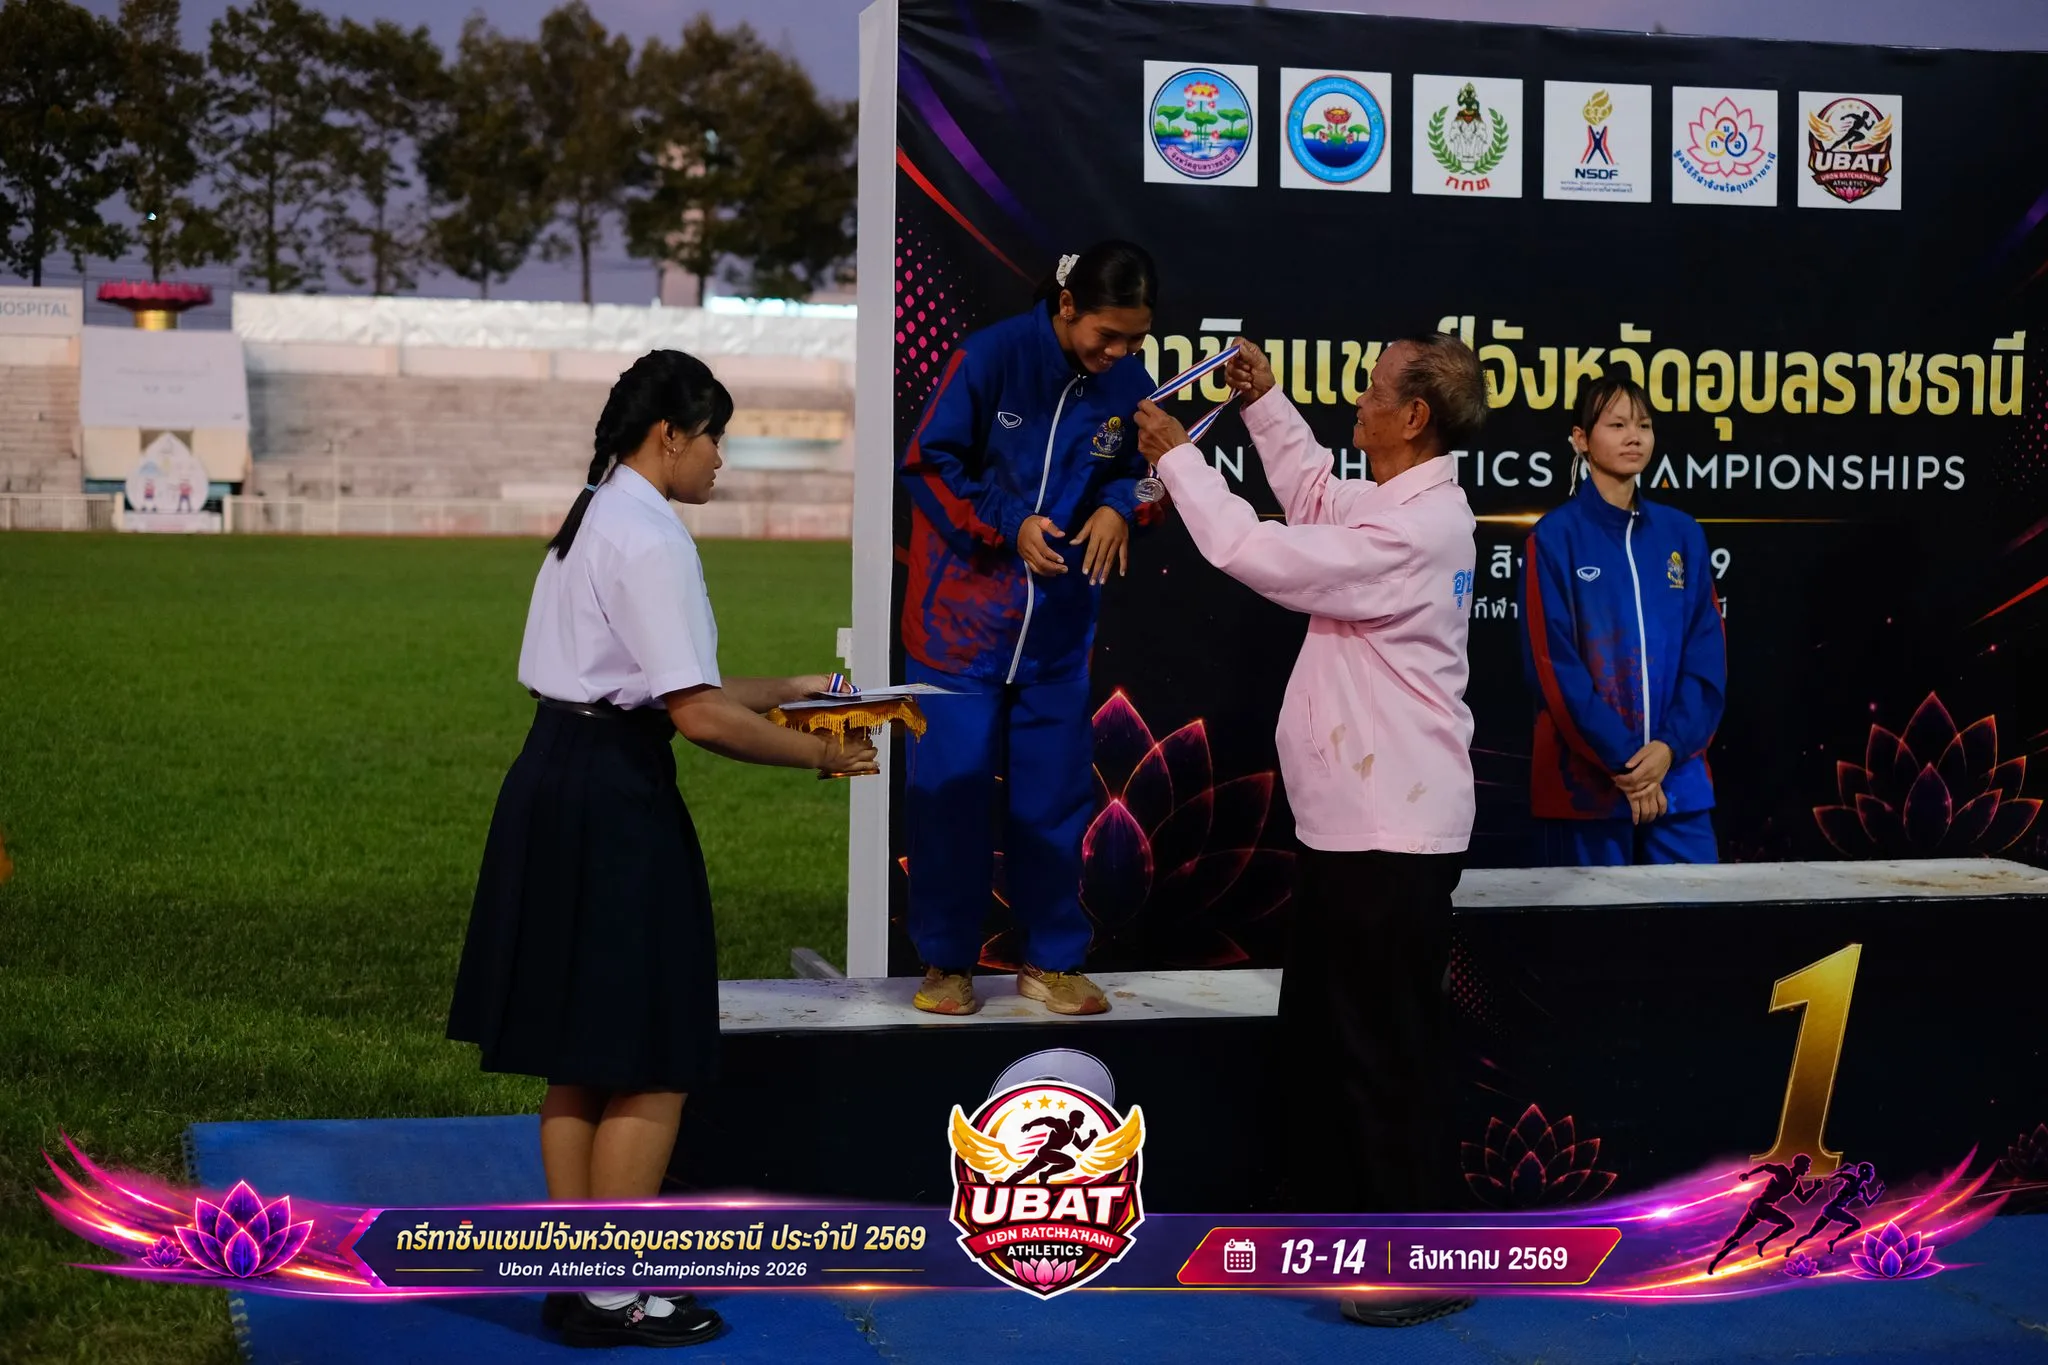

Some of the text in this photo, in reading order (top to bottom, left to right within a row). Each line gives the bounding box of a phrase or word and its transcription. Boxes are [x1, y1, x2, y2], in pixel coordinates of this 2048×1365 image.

[1575, 168, 1619, 180] NSDF
[1815, 151, 1885, 173] UBAT
[1580, 453, 1965, 491] AMPIONSHIPS
[1748, 943, 1863, 1178] 1
